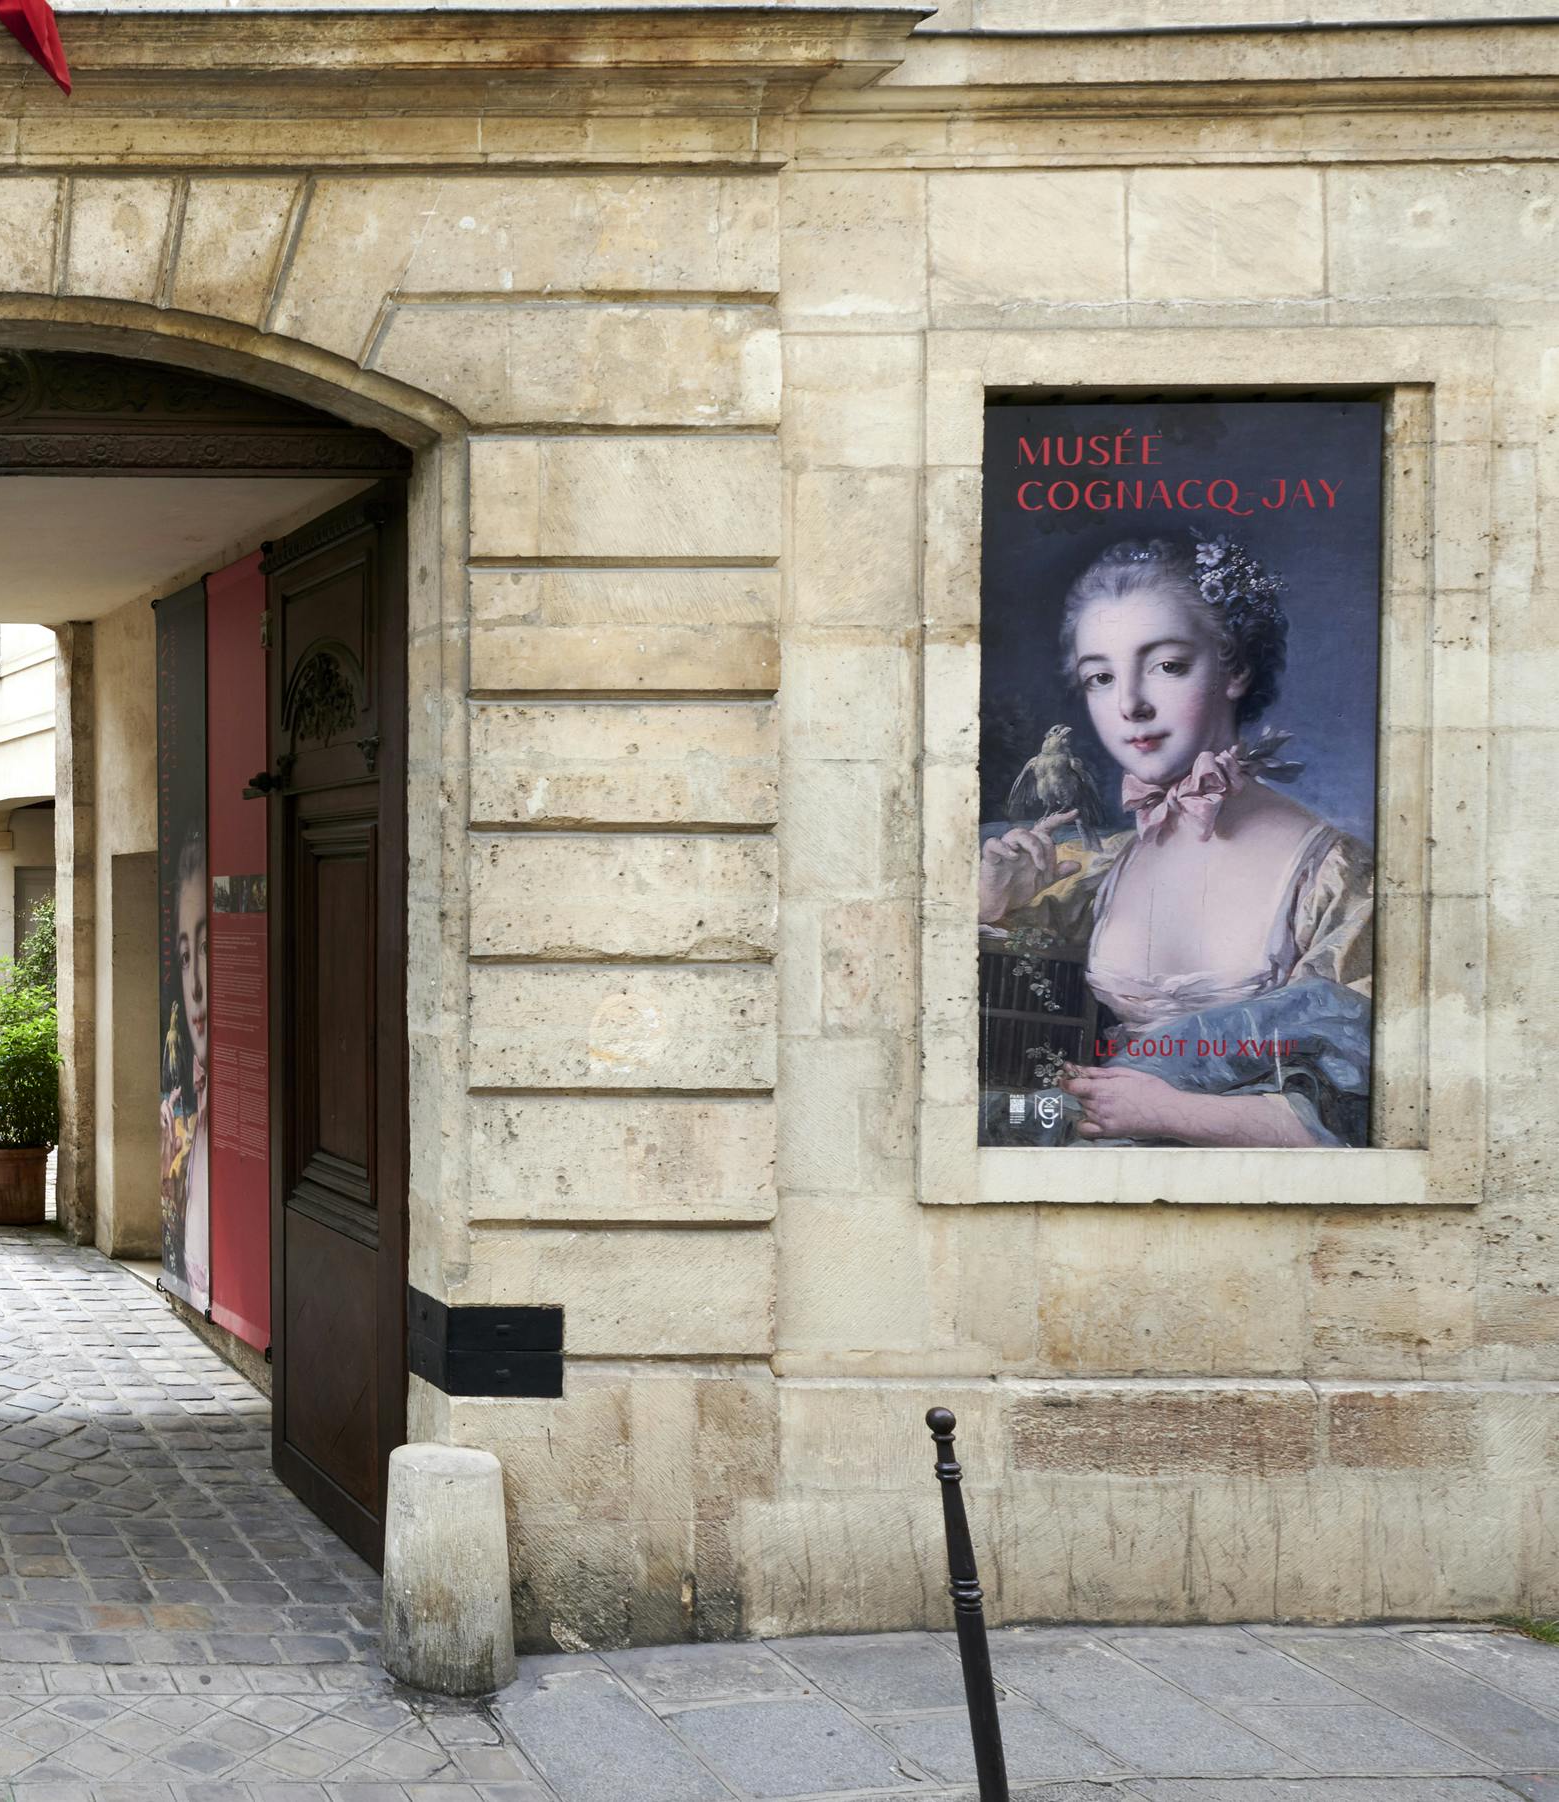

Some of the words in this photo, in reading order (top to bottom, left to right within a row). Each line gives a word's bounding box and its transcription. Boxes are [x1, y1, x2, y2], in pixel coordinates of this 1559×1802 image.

[1018, 428, 1163, 466] MUSÉE
[1017, 479, 1345, 517] COGNACQ-JAY
[1095, 1039, 1118, 1057] LE
[1128, 1034, 1186, 1057] GOÛT
[1198, 1039, 1227, 1057] DU
